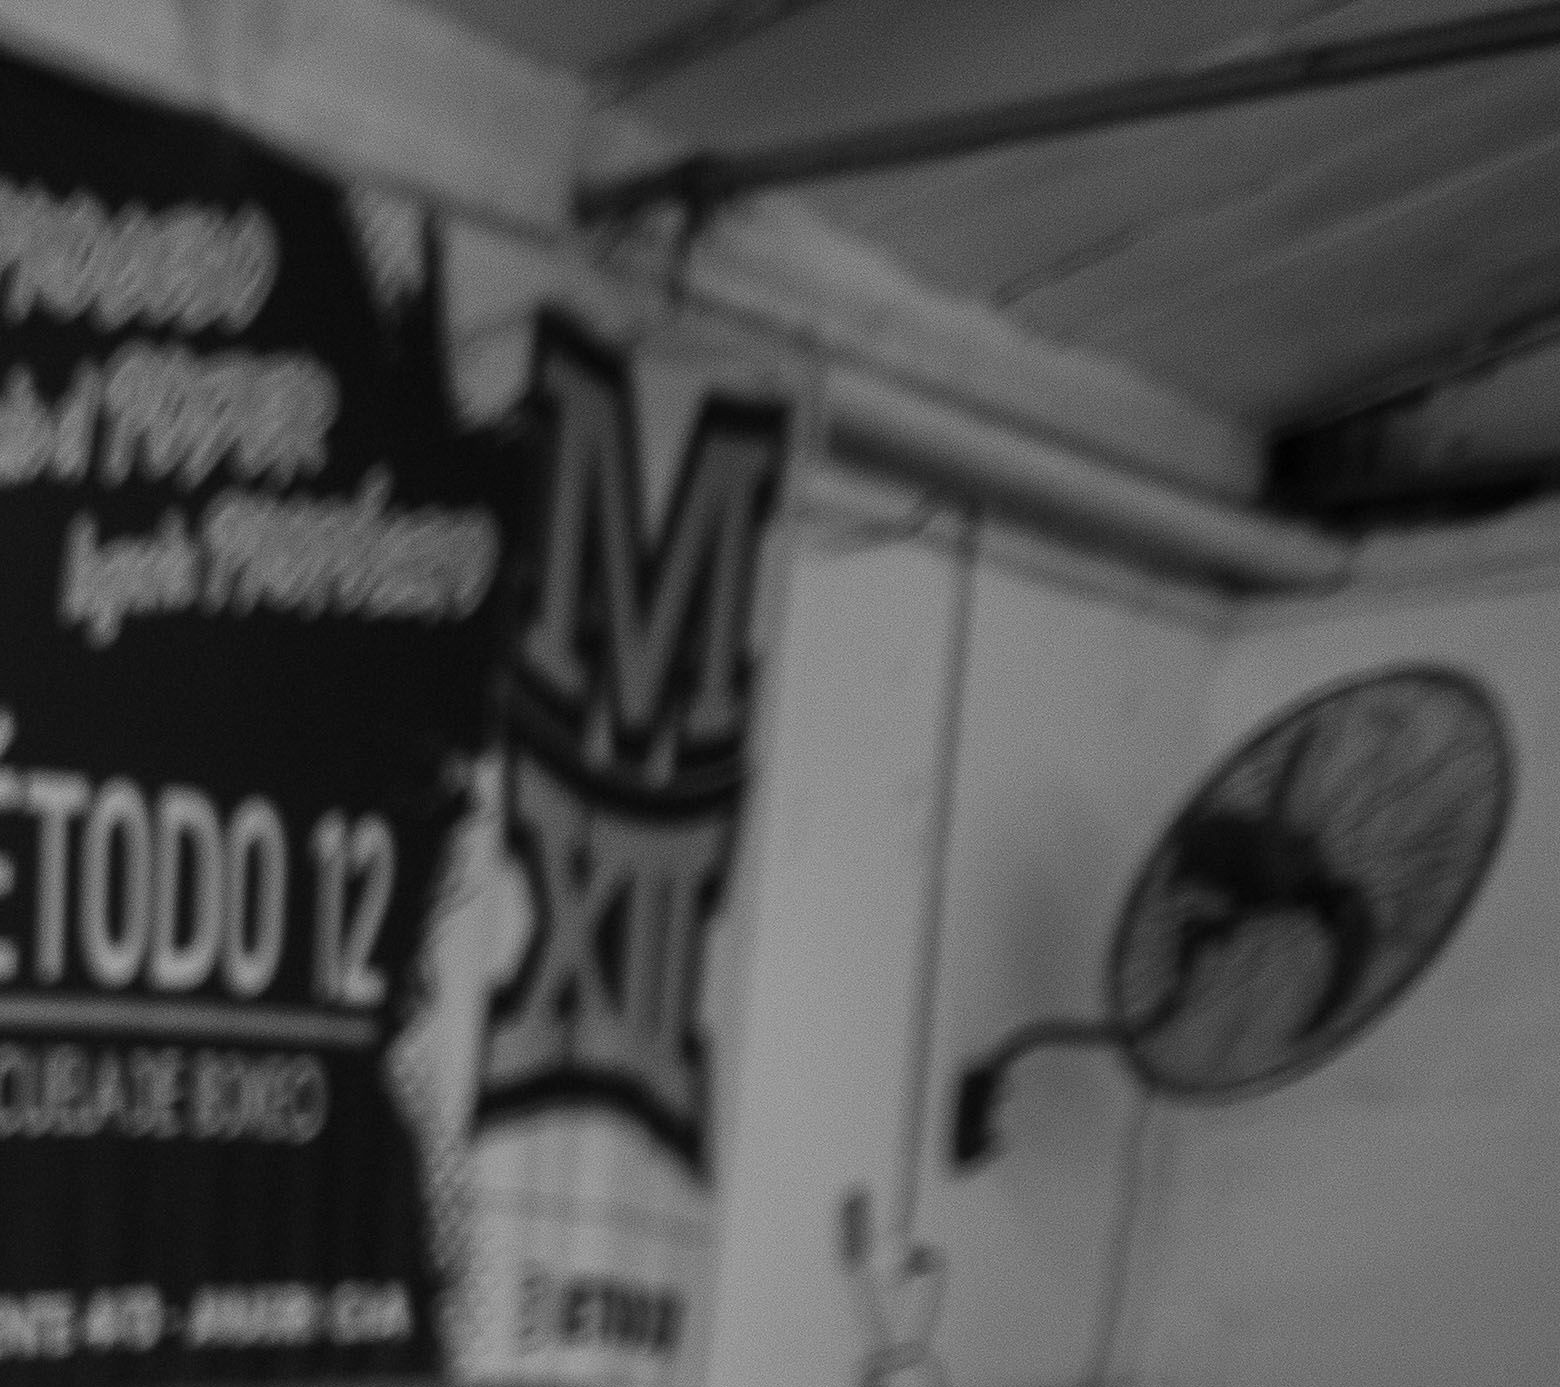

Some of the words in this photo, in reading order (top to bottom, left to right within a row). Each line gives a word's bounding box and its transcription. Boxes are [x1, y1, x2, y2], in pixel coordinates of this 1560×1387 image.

[310, 810, 396, 1003] 12
[128, 1046, 188, 1140] DE
[194, 1050, 330, 1145] BOXEO
